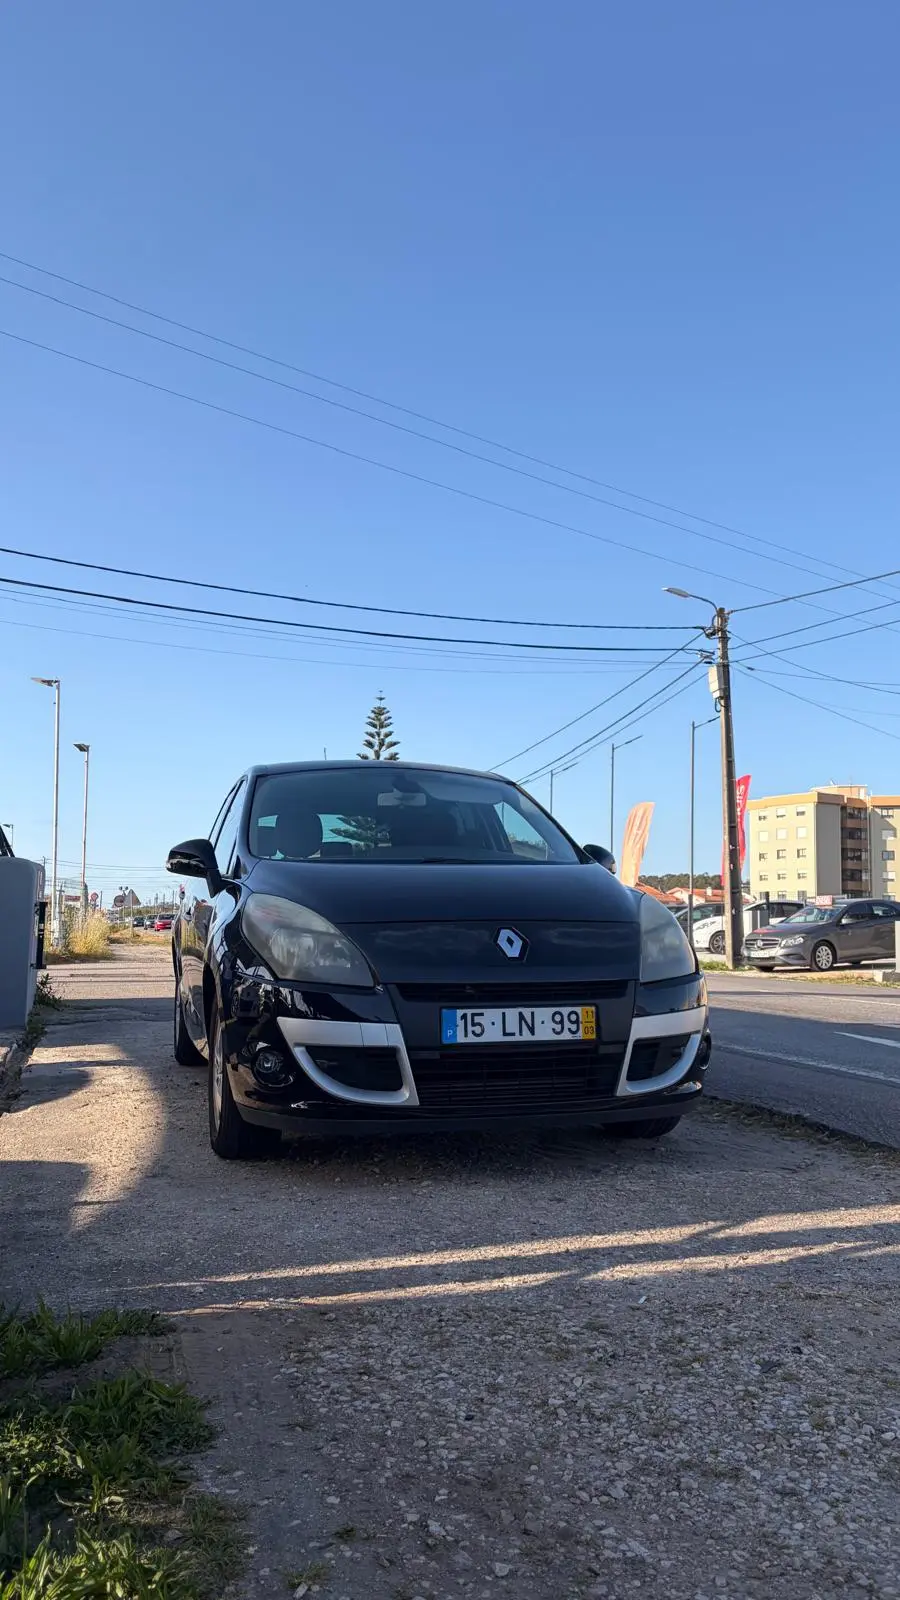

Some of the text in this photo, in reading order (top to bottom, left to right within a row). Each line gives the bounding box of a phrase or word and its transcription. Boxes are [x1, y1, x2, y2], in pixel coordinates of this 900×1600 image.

[585, 1010, 594, 1019] 11
[447, 1030, 453, 1038] P
[584, 1026, 594, 1035] 03
